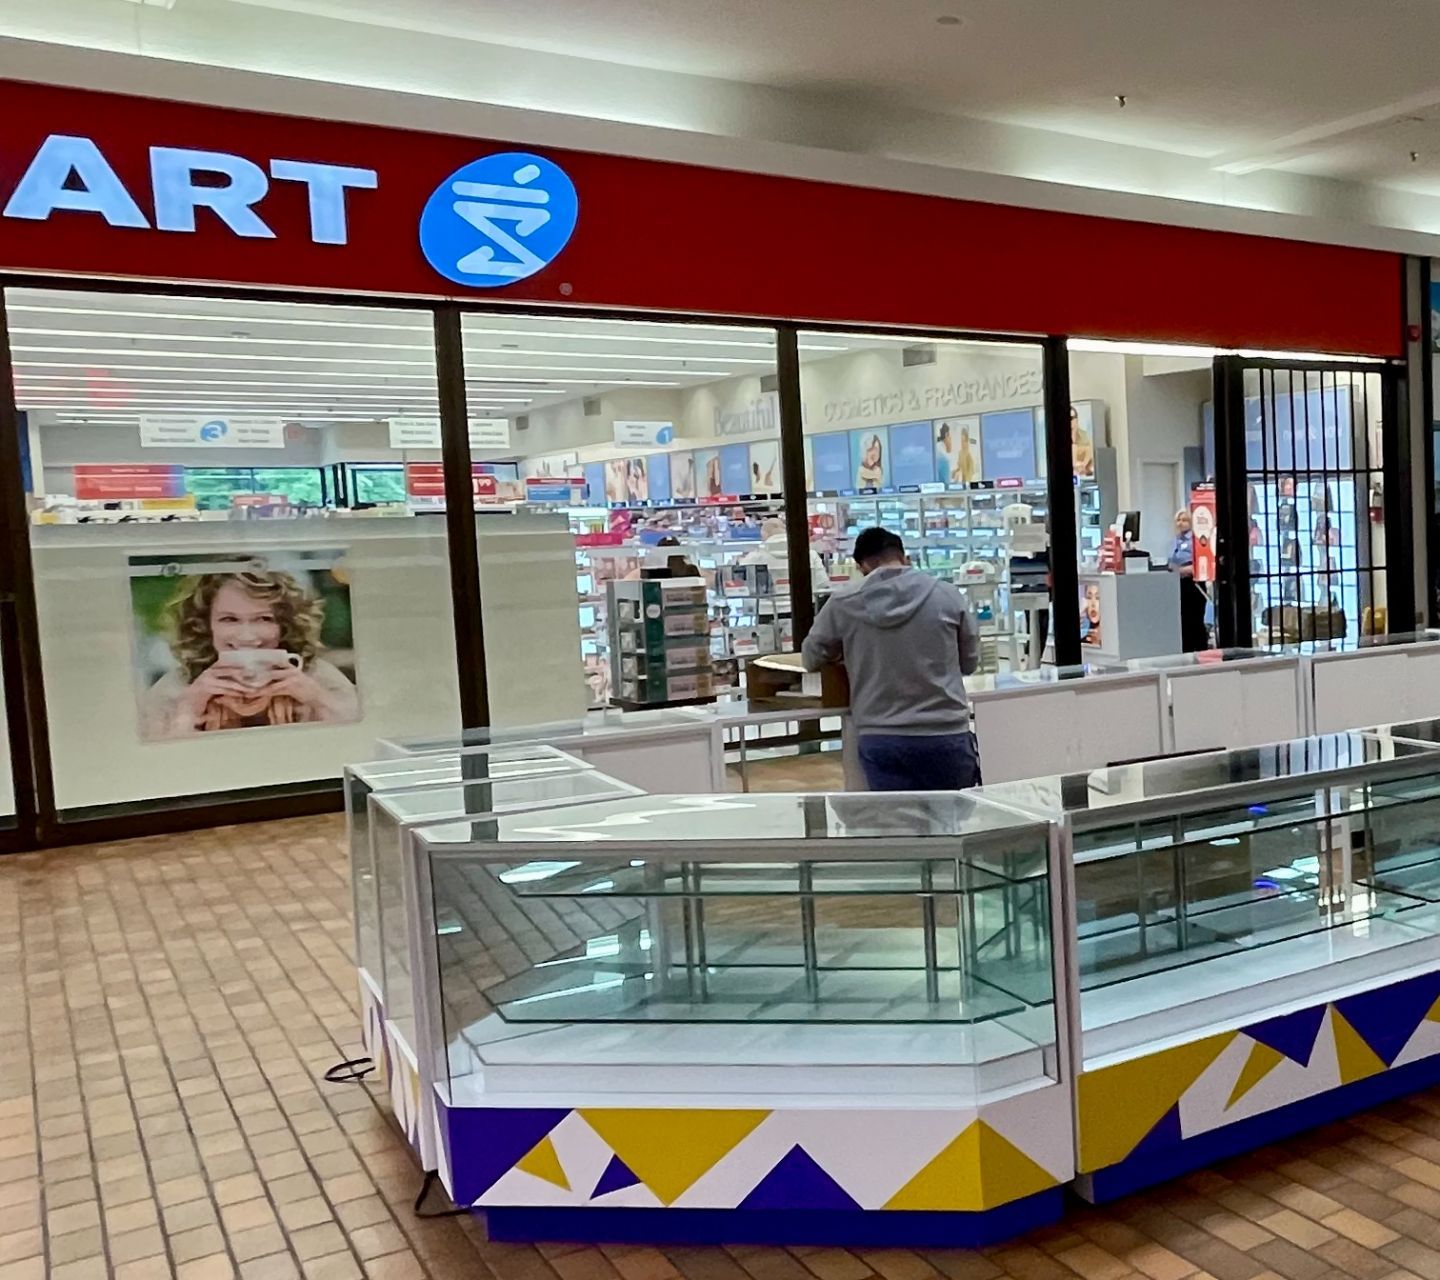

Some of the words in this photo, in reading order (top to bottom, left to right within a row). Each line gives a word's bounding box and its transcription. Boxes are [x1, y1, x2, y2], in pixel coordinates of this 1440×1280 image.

[3, 134, 378, 245] ART
[824, 388, 905, 422] COSMETICS
[924, 370, 1043, 408] FRAGRANCES
